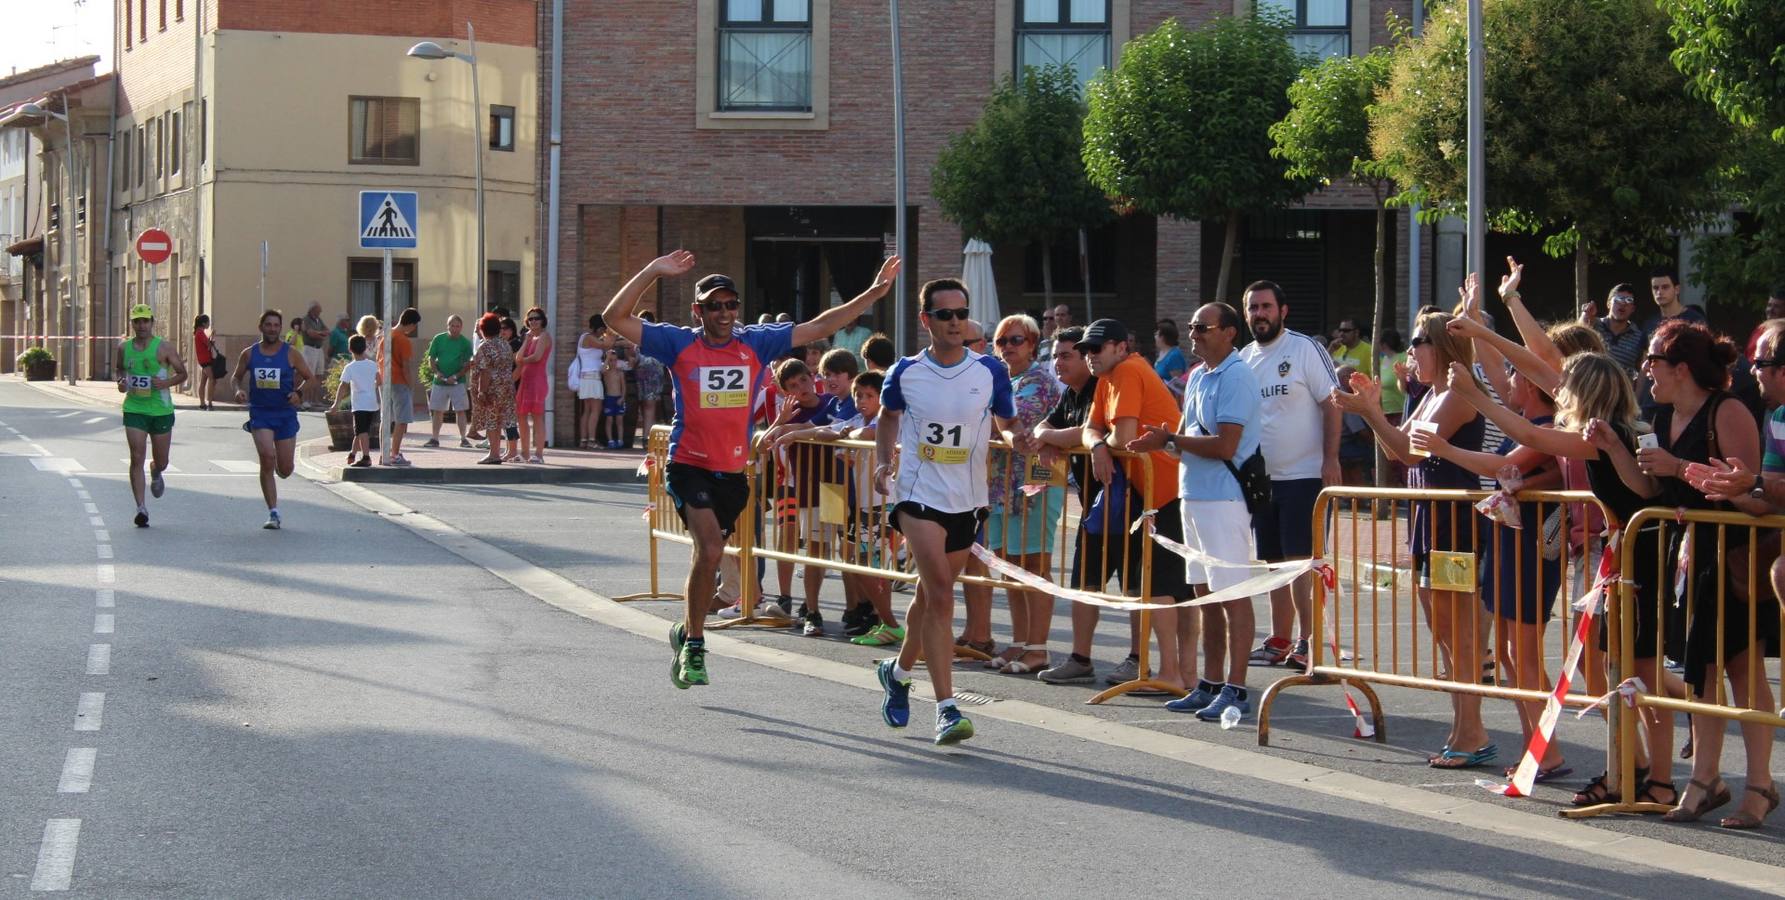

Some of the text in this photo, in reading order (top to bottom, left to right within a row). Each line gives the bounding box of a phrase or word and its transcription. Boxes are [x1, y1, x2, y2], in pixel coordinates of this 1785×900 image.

[131, 376, 148, 388] 25
[258, 369, 277, 380] 34
[708, 369, 744, 390] 52
[926, 422, 962, 447] 31
